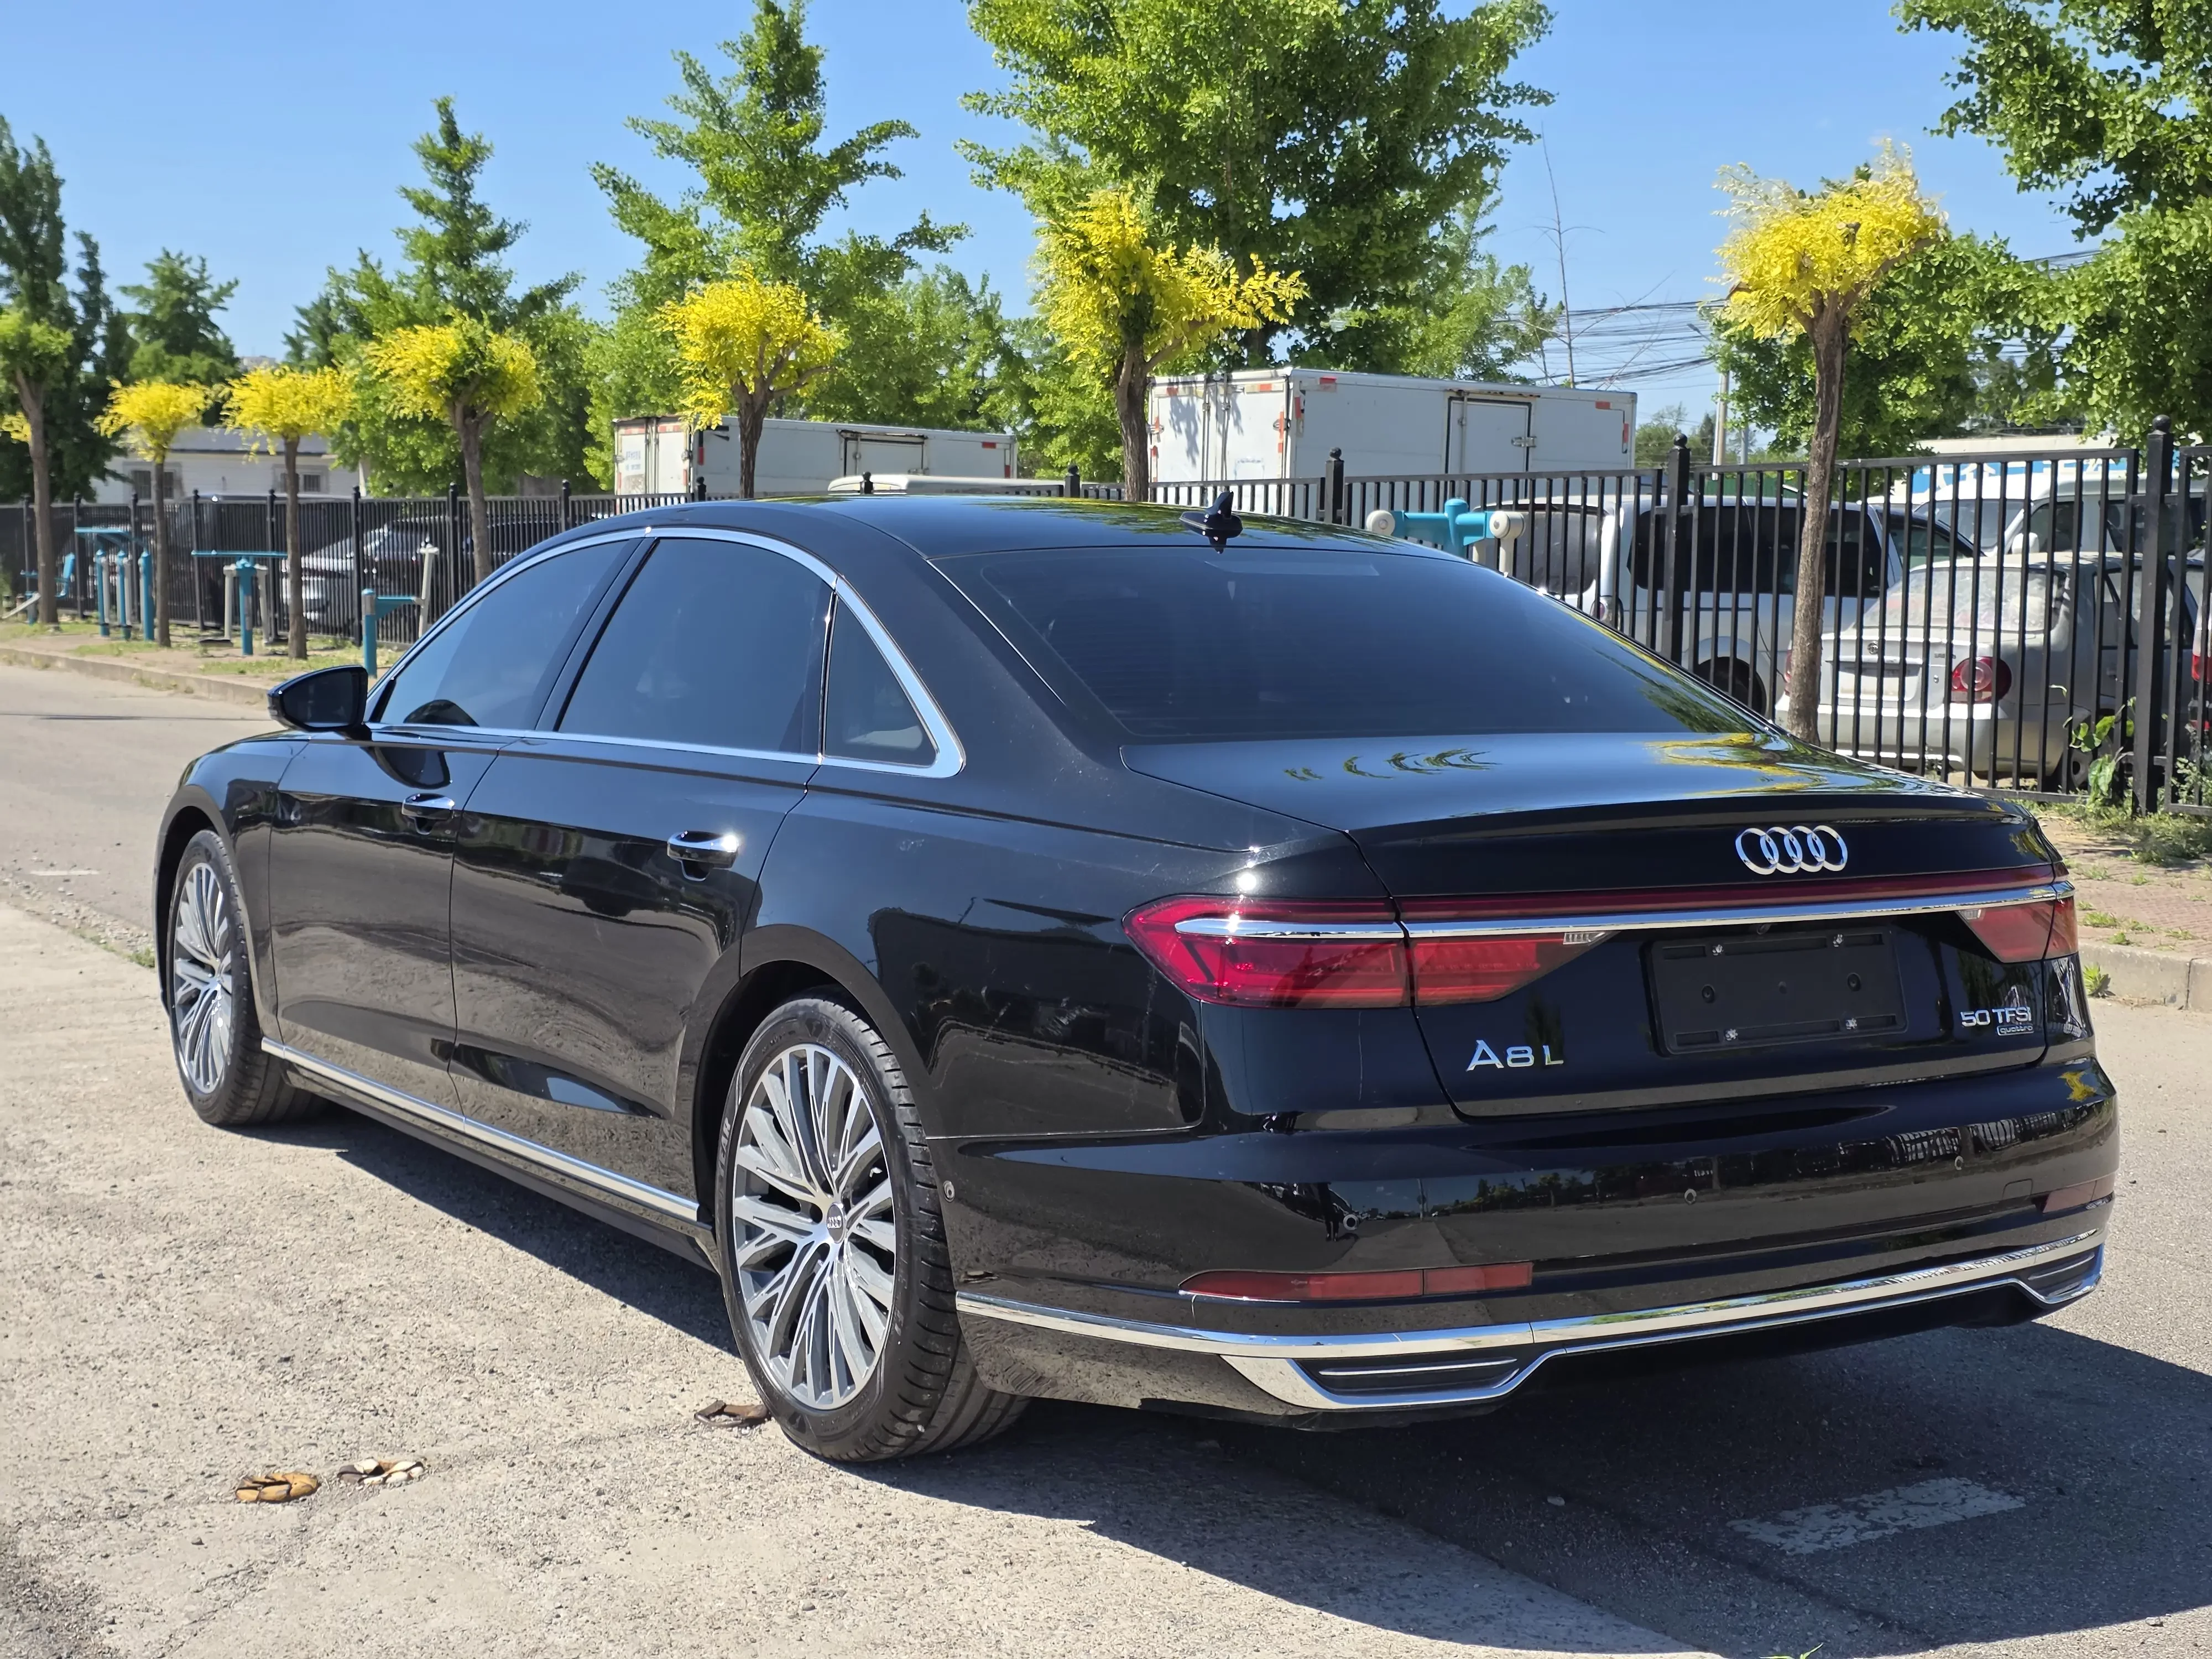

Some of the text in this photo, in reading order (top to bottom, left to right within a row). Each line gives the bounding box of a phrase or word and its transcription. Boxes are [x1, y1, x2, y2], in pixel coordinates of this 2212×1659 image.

[1960, 1006, 2032, 1027] 50 TFSI
[2000, 1025, 2033, 1035] quattro
[1466, 1040, 1564, 1071] A8 L
